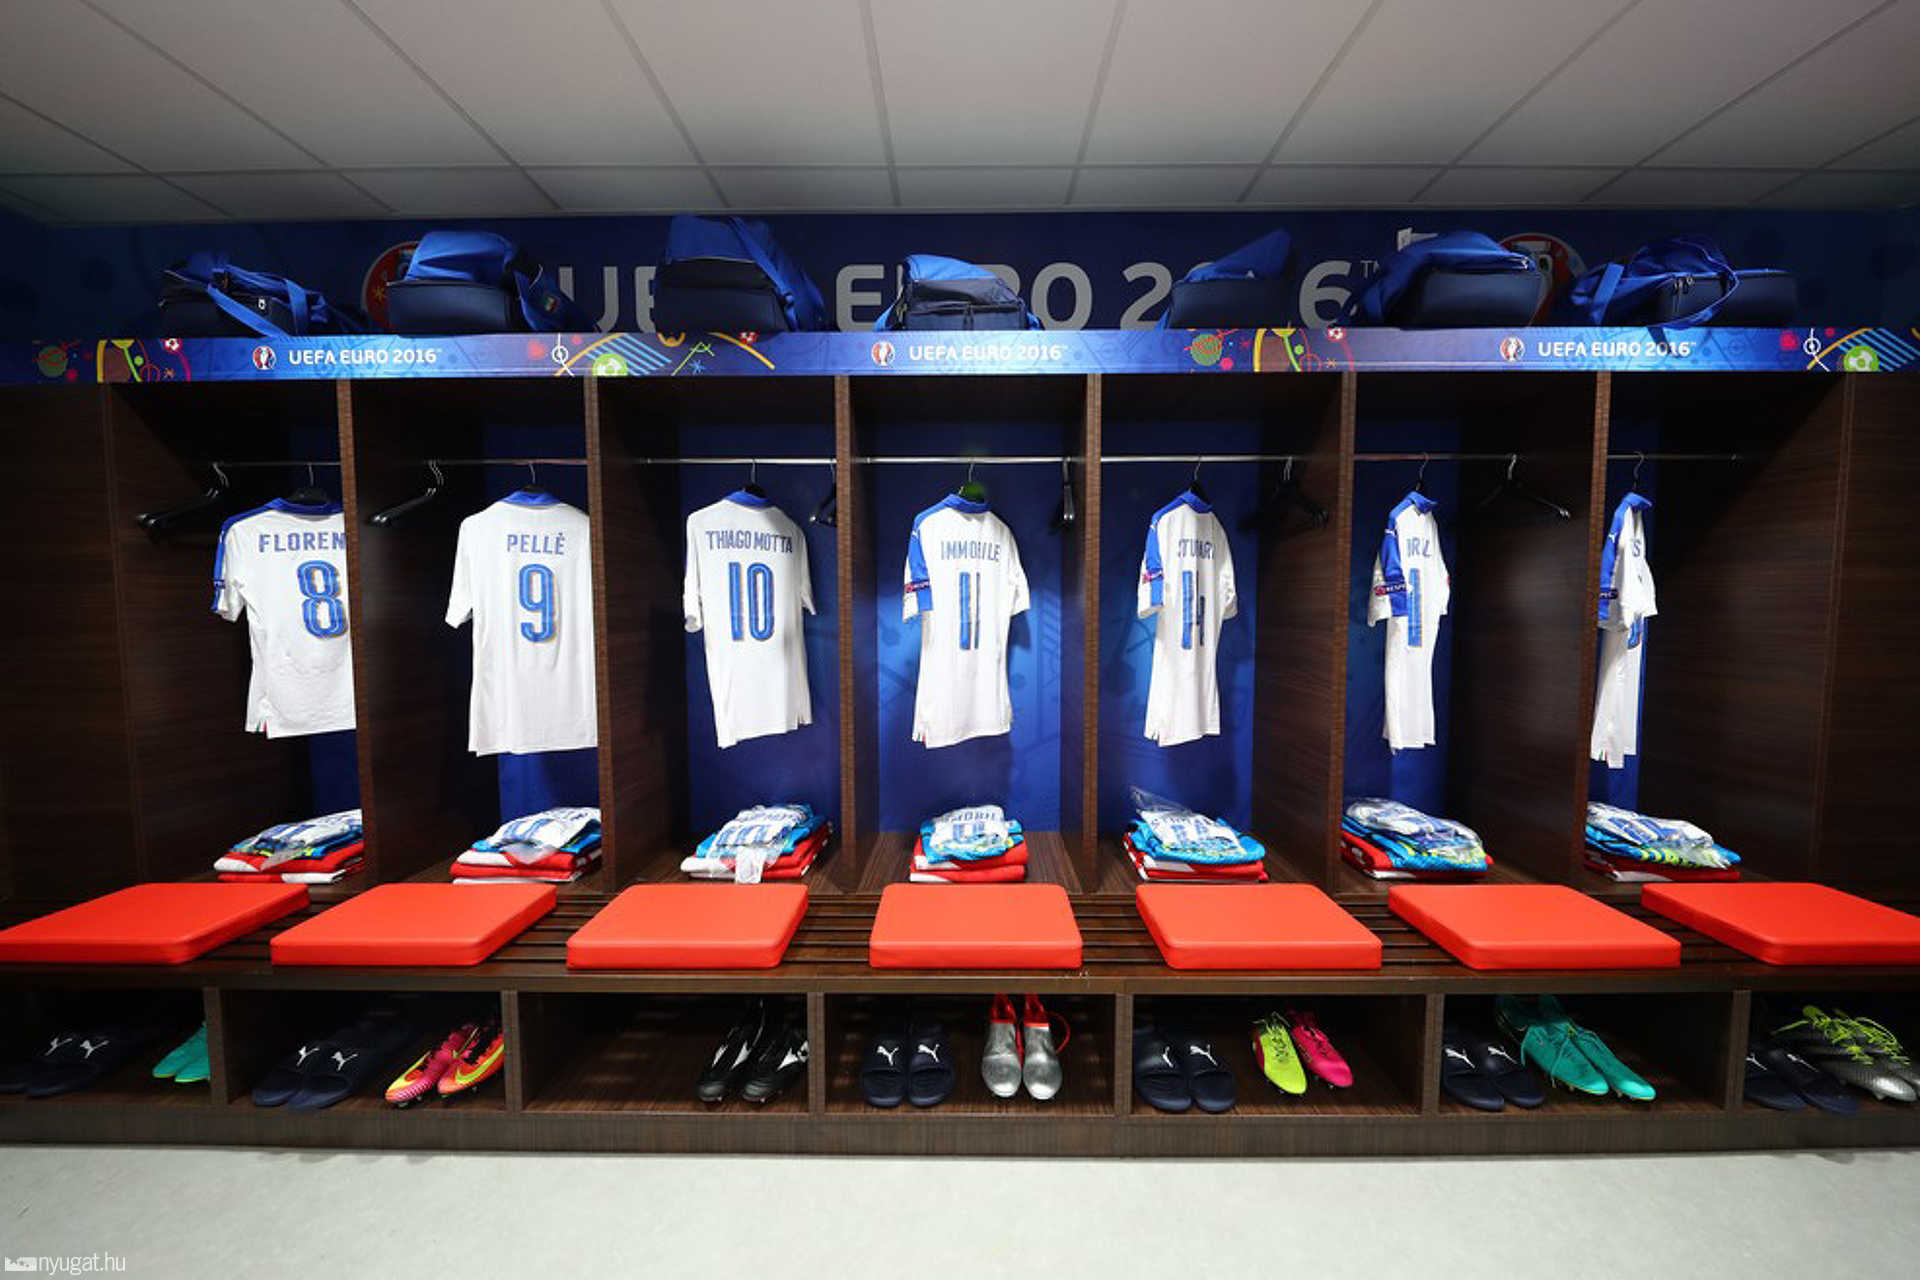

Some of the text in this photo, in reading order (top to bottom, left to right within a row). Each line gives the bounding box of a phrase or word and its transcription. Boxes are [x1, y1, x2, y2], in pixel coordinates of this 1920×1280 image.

[836, 262, 1092, 331] EO
[1120, 260, 1358, 331] 26
[289, 349, 337, 365] UEFA
[340, 348, 388, 365] EURO
[909, 344, 958, 361] UEFA
[962, 344, 1010, 361] EURO
[1538, 341, 1587, 357] UEFA
[1591, 341, 1641, 357] EURO
[258, 532, 347, 553] FLOREN
[705, 529, 793, 553] THIAGO MOTTA
[297, 560, 349, 638] 8
[519, 563, 556, 643] 9
[728, 561, 775, 642] 10
